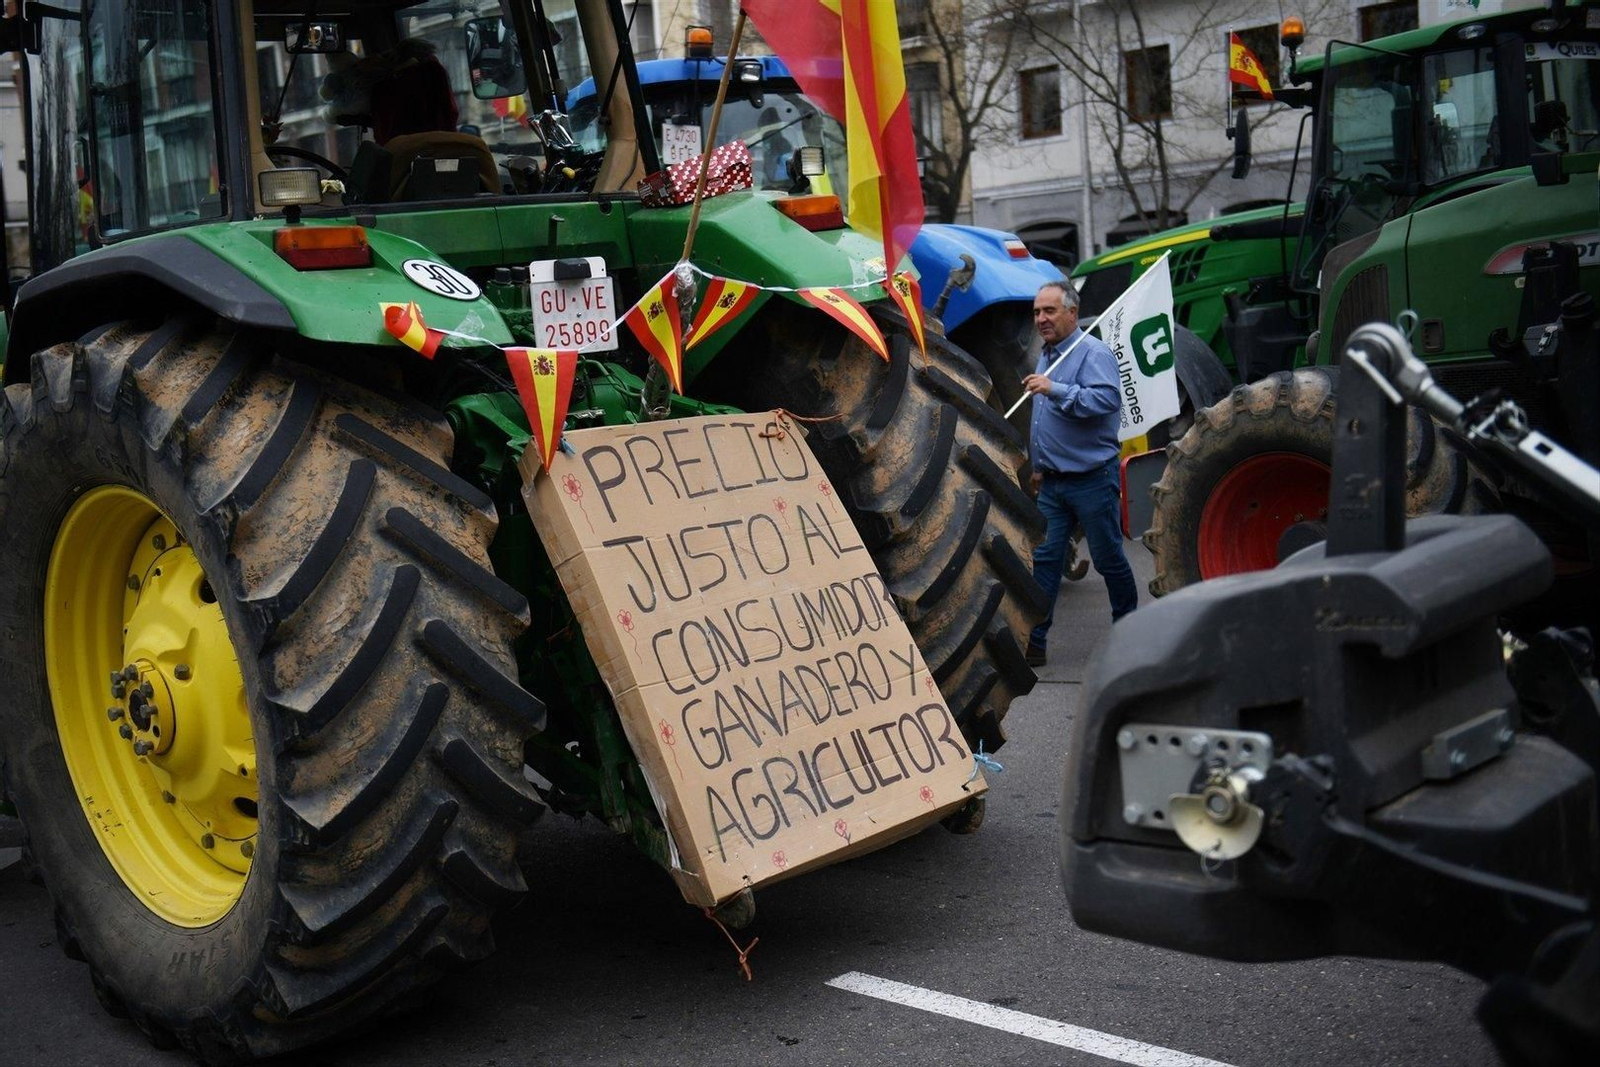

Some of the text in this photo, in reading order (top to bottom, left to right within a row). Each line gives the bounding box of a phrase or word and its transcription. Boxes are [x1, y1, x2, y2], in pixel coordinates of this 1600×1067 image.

[1557, 42, 1597, 57] QUILES
[666, 128, 697, 143] E 4730
[411, 263, 472, 295] 30
[1113, 343, 1124, 360] de
[1118, 360, 1144, 424] Uniones
[582, 422, 809, 523] PRECIO
[602, 502, 864, 613] JUSTO AL
[652, 572, 904, 695] CONSUMIDOR
[681, 643, 917, 770] GANADERO Y
[706, 702, 967, 863] AGRICULTOR
